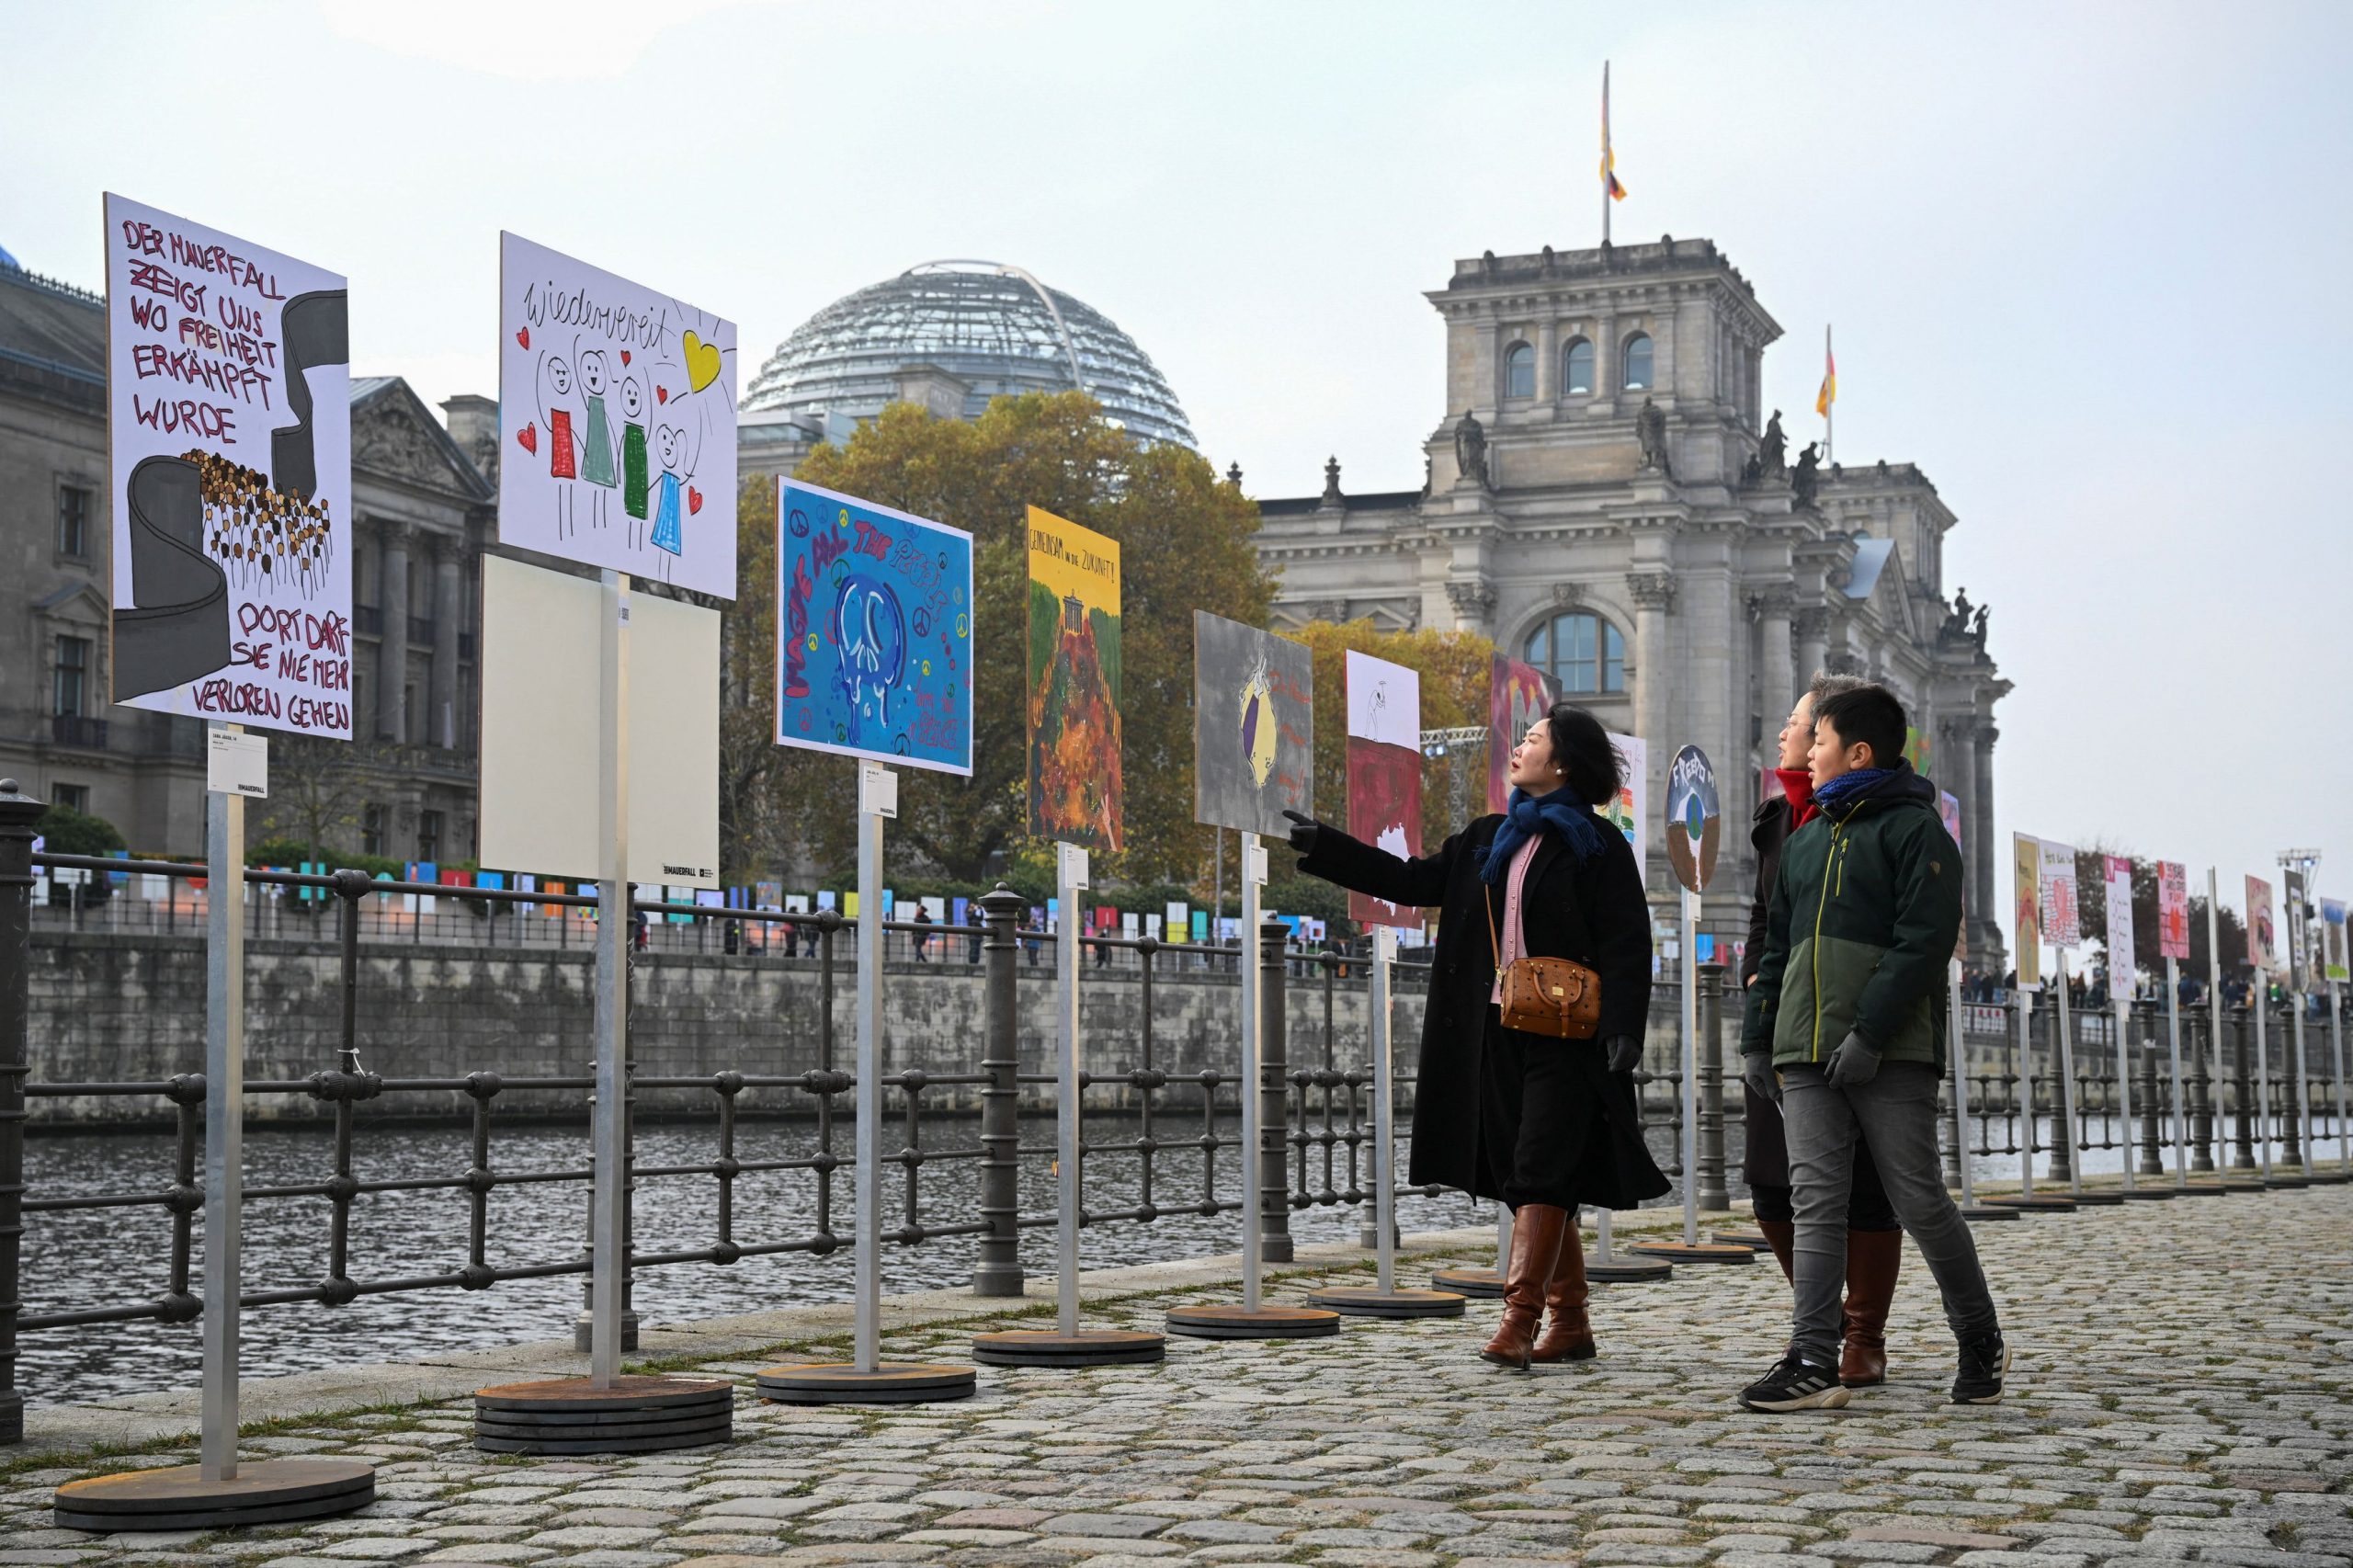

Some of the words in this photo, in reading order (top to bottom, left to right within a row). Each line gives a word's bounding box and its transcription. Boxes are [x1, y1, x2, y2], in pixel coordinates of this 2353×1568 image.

[122, 220, 165, 259] DER
[169, 232, 286, 300] MAUERFALL
[129, 258, 207, 316] ZEIGT
[219, 295, 263, 337] UNS
[131, 295, 167, 332] WO
[178, 317, 277, 369] FREIHEIT
[132, 344, 271, 411] ERKÄMPFT
[133, 393, 236, 444] WURDE
[1029, 528, 1064, 561] GEMEINSAM
[305, 610, 350, 657] DARF
[233, 642, 272, 670] SIE
[278, 648, 310, 682] NIE
[313, 658, 349, 691] MEHR
[193, 678, 280, 720] VERLOREN
[287, 694, 349, 730] GEHEN
[1672, 752, 1714, 788] FREEDOM
